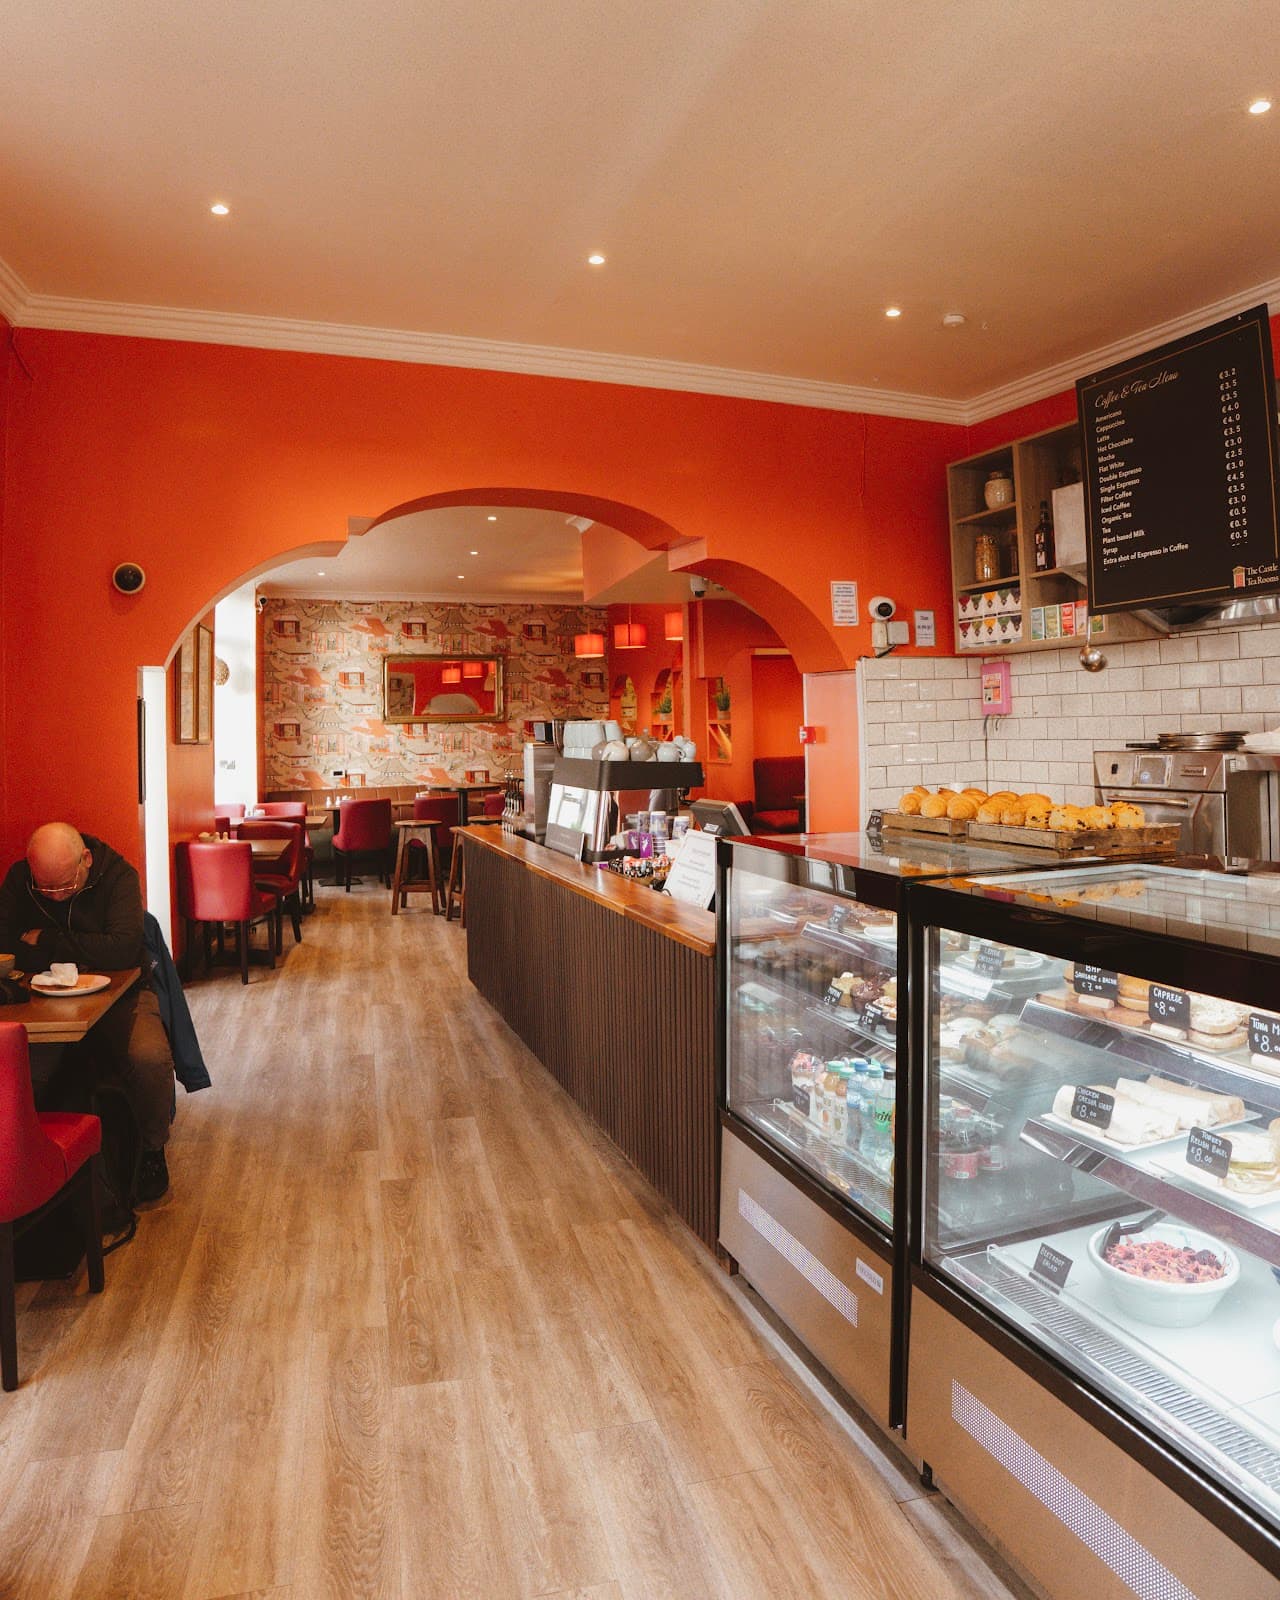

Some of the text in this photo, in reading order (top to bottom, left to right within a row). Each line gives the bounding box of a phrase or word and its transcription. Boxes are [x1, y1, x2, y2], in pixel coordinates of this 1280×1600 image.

[1095, 370, 1179, 409] Coffee & Tea Menu
[1096, 410, 1122, 423] Americano
[1096, 419, 1126, 433] Cappuccino
[1096, 434, 1110, 443] Latte
[1097, 437, 1134, 453] Hot Chocolate
[1098, 453, 1115, 463] Mocha
[1099, 461, 1125, 473] Flat White
[1100, 467, 1143, 483] Double Espresso
[1100, 478, 1140, 494] Single Espresso
[1100, 490, 1132, 503] Filter Coffee
[1101, 502, 1131, 514] Iced Coffee
[1101, 514, 1122, 524] Organic
[1116, 532, 1132, 542] based
[1133, 529, 1145, 538] Milk
[1103, 547, 1118, 556] Syrup
[1103, 557, 1117, 565] Extra
[1118, 554, 1130, 562] shot
[1137, 549, 1162, 559] Espresso
[1169, 542, 1189, 552] Coffee
[1246, 563, 1279, 575] The Castle
[1246, 575, 1279, 585] Tea Rooms
